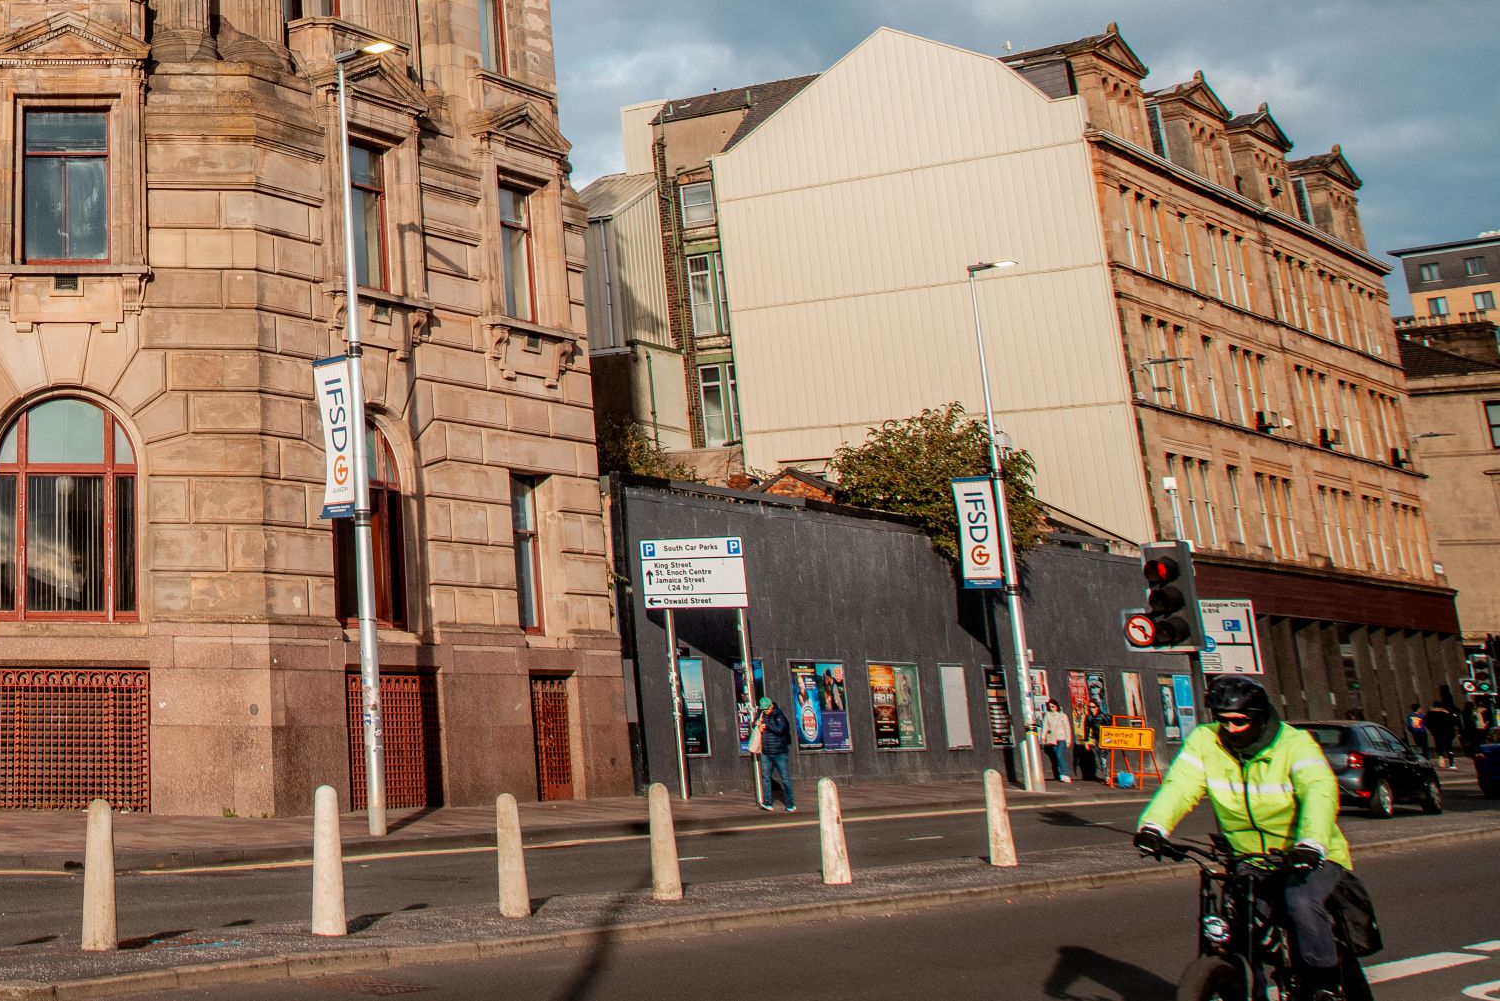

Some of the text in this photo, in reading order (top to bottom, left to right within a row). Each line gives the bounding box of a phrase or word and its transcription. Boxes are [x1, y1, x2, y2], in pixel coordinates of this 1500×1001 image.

[325, 378, 348, 452] IFSD
[963, 492, 989, 543] IFSD
[663, 597, 688, 605] Oswald
